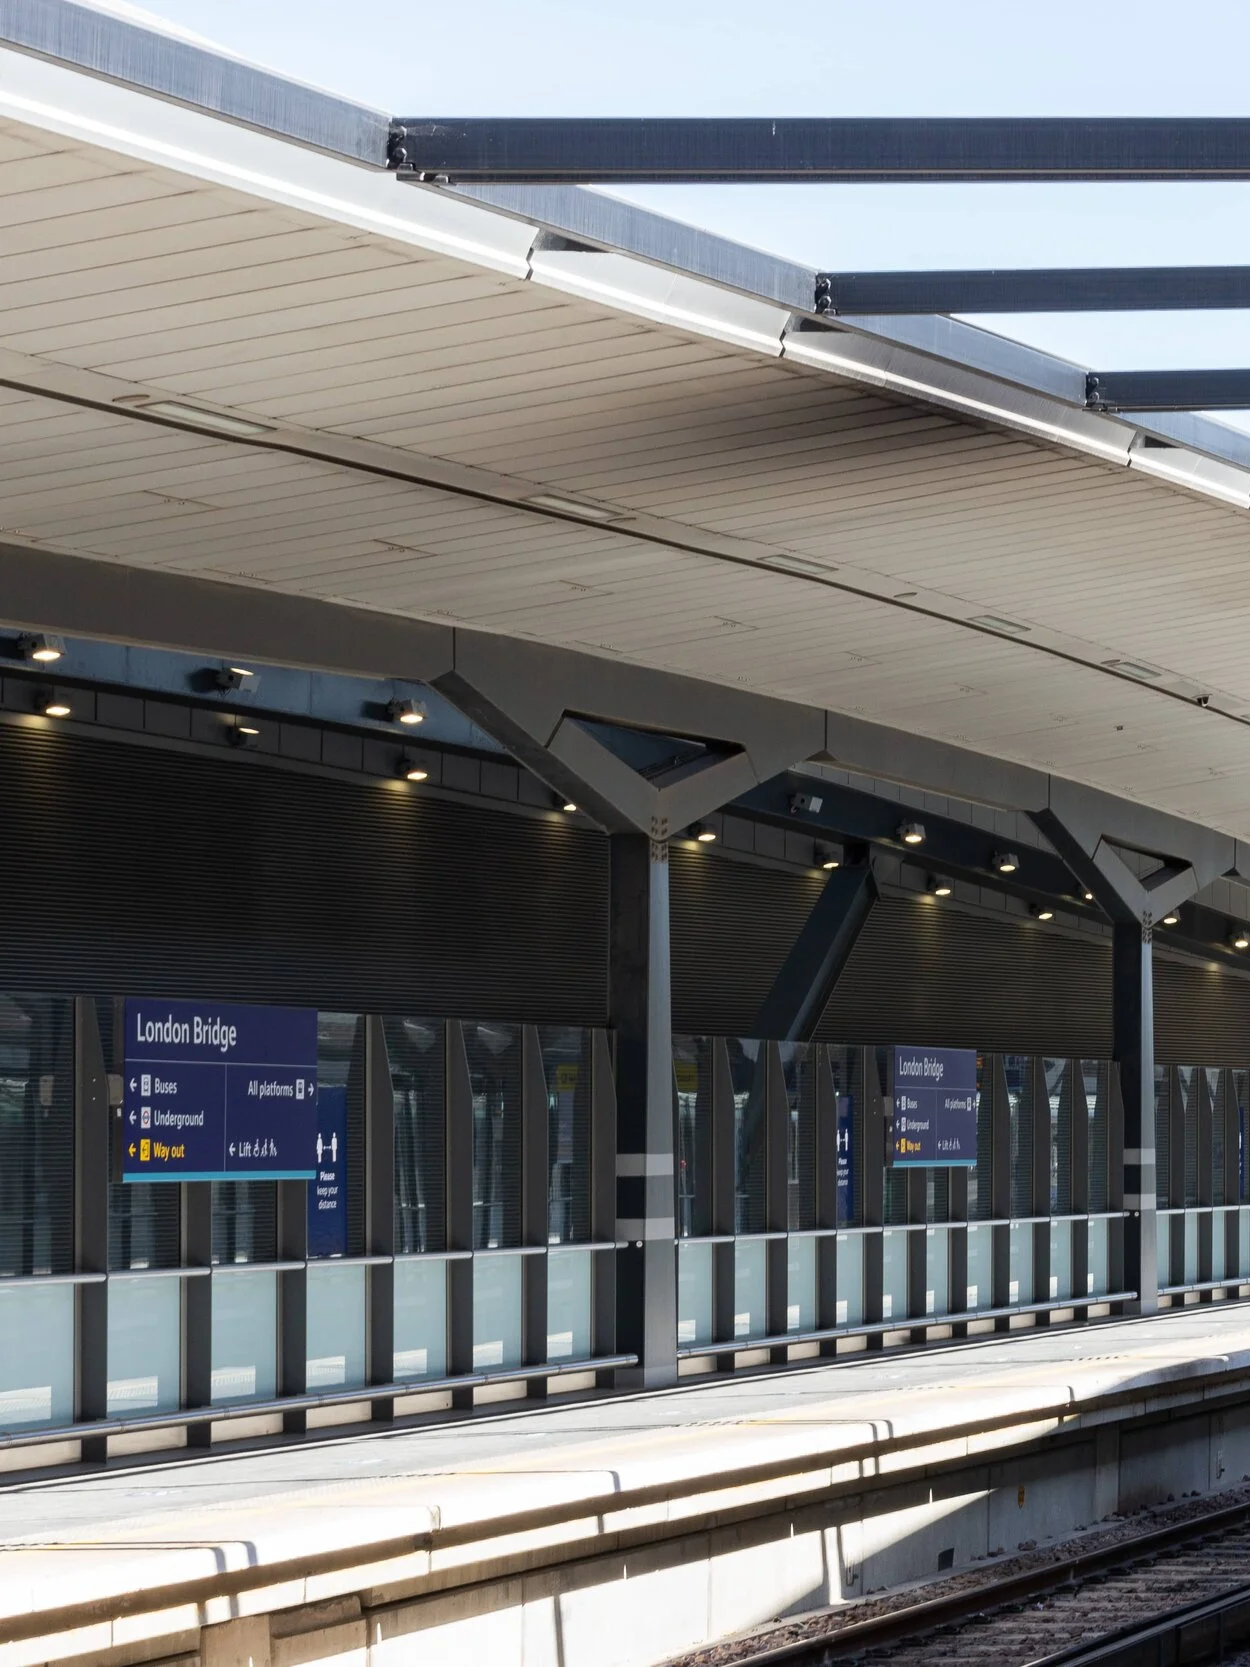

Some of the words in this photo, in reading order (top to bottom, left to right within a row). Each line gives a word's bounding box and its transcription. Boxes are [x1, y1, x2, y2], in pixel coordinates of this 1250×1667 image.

[137, 1012, 190, 1043] London
[193, 1015, 237, 1053] Bridge
[899, 1055, 923, 1076] London
[924, 1056, 944, 1081] Bridge
[154, 1077, 178, 1094] Buses
[247, 1080, 258, 1096] All
[259, 1080, 294, 1100] platforms
[154, 1109, 204, 1130] Underground
[153, 1142, 170, 1162] Way
[171, 1143, 185, 1158] out
[238, 1141, 252, 1158] Lift
[320, 1170, 336, 1181] Please
